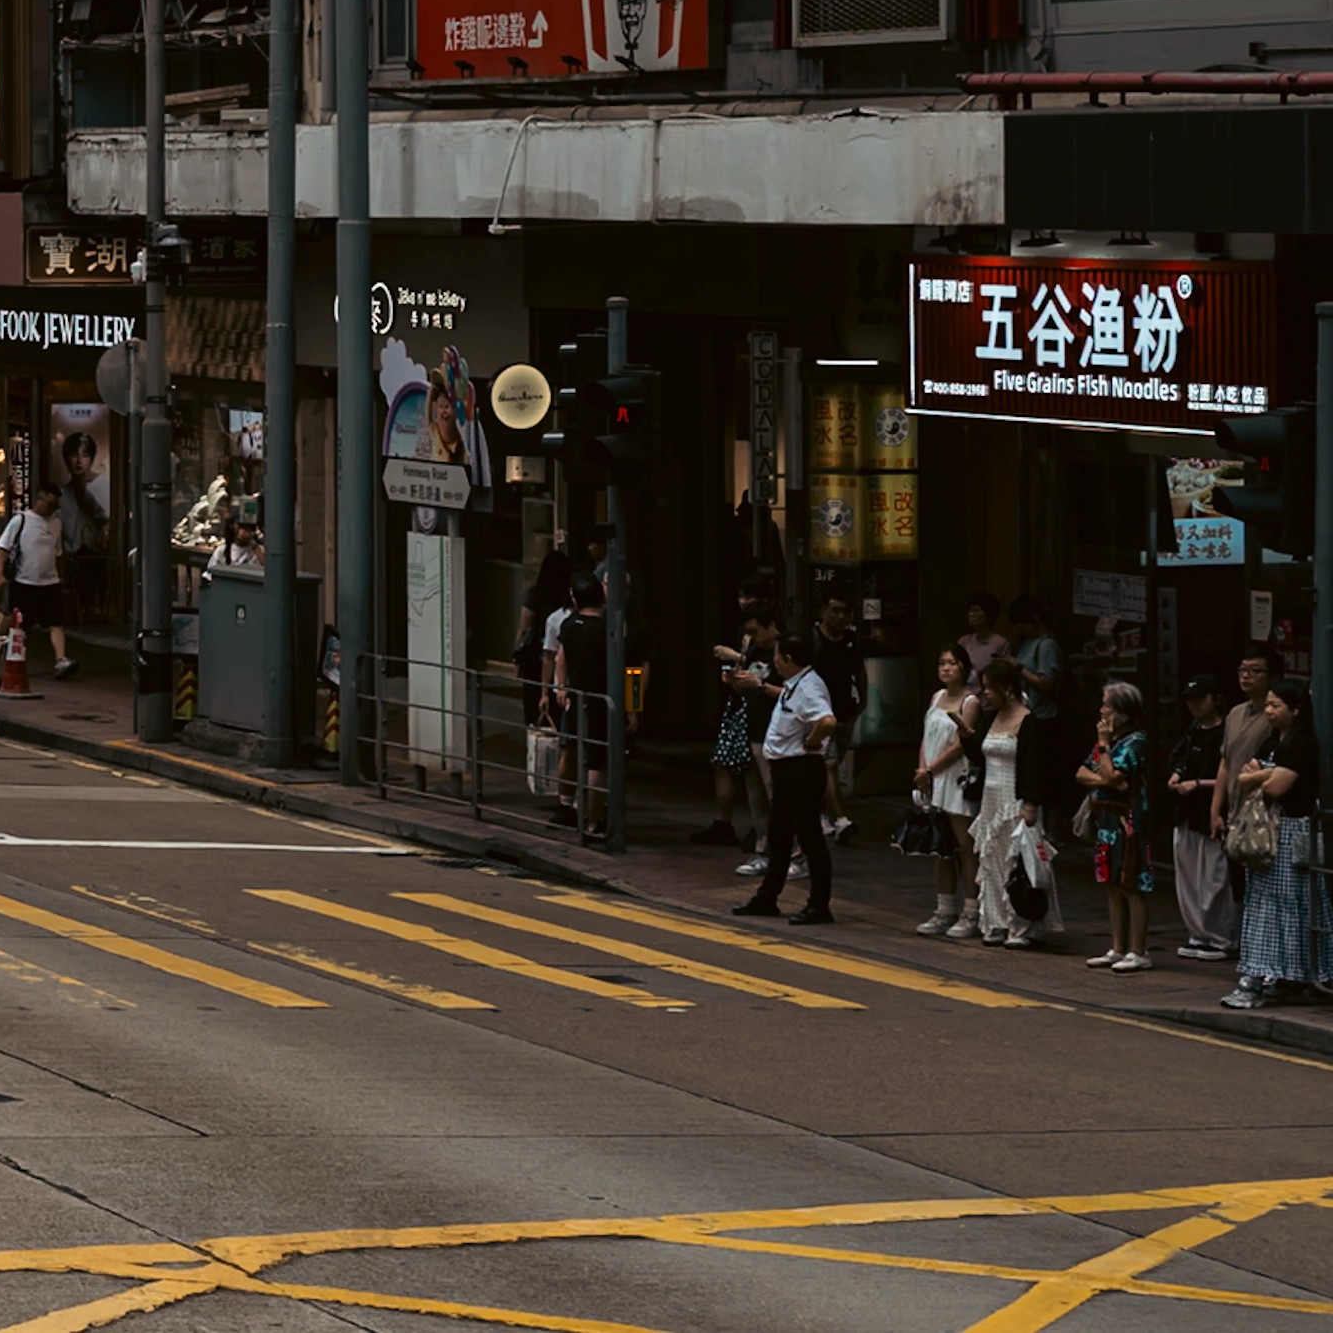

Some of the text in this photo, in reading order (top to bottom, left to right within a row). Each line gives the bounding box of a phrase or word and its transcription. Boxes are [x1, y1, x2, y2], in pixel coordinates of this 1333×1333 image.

[39, 232, 146, 275] 寶湖
[43, 312, 135, 350] JEWELLERY
[975, 281, 1183, 373] 五谷渔粉
[993, 368, 1179, 402] Five Grains Fish Noodles
[814, 569, 835, 581] 3/F
